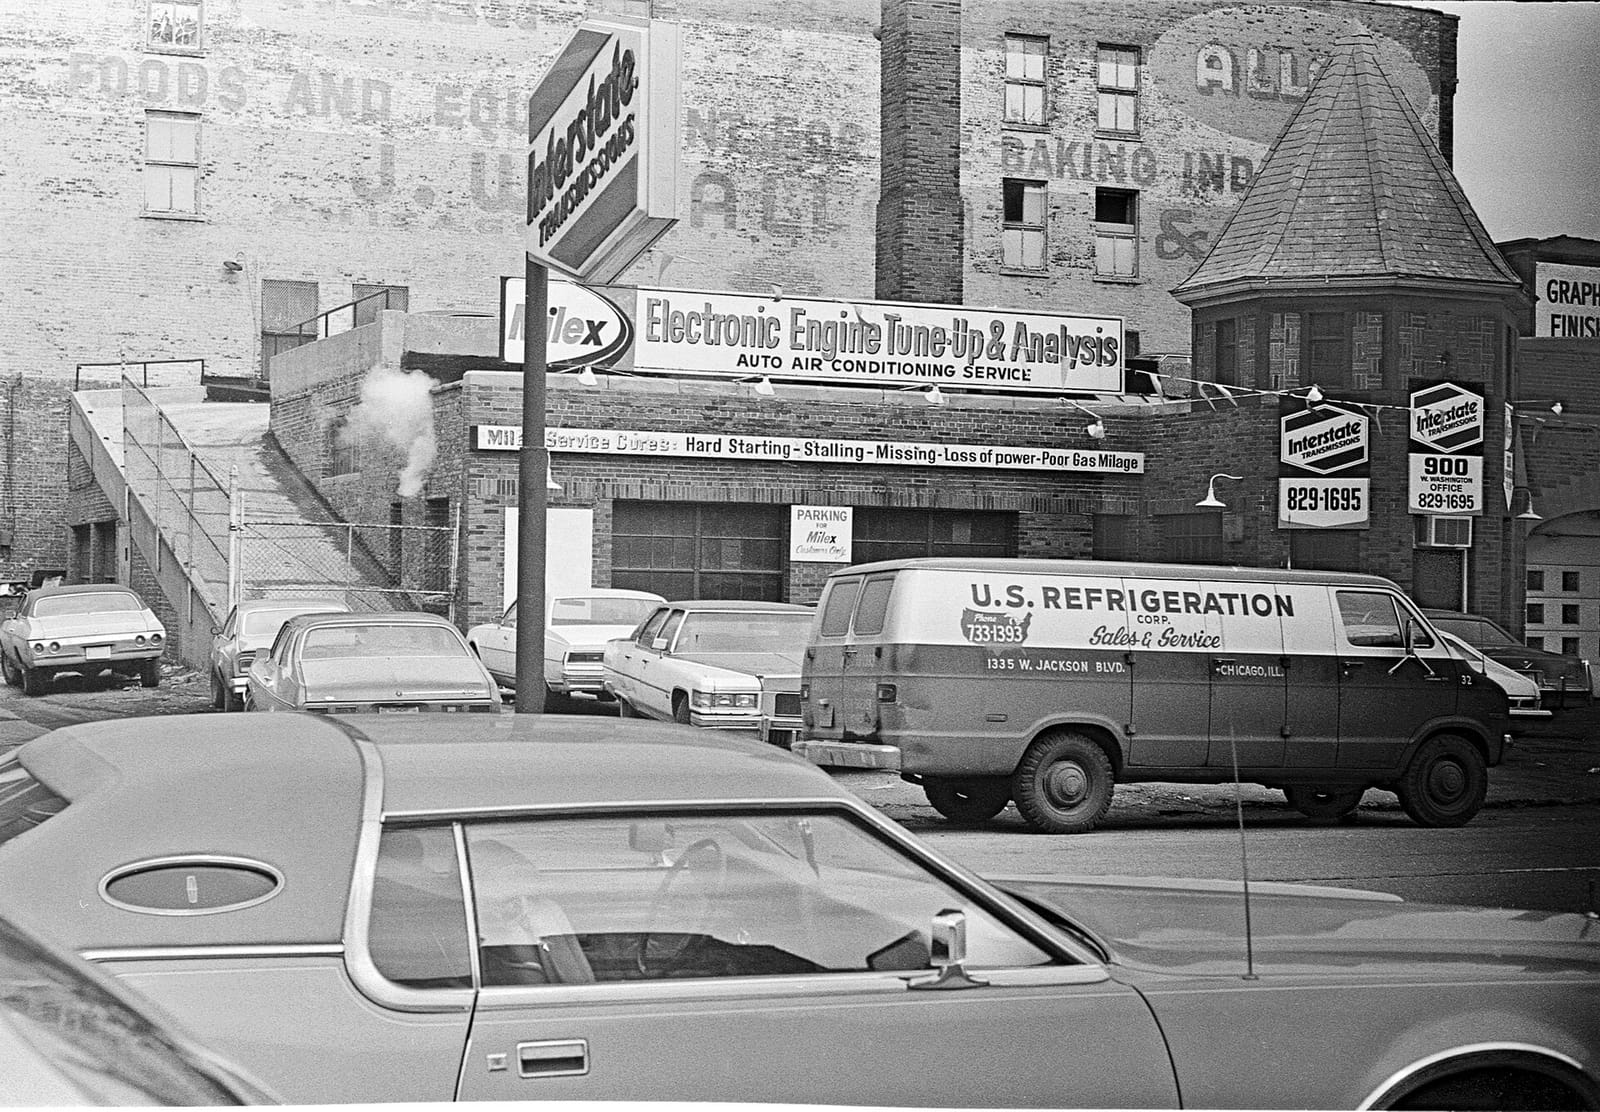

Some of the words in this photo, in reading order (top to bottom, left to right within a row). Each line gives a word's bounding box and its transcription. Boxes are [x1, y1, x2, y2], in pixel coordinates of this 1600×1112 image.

[1196, 44, 1325, 102] ALL
[69, 52, 248, 112] FOODS
[284, 68, 392, 125] AND
[1001, 135, 1156, 186] BAKING
[1182, 150, 1256, 194] IND
[527, 38, 635, 226] Interstate
[646, 297, 781, 349] Electronic
[790, 307, 882, 361] Engine
[884, 313, 984, 364] Tune-Up
[986, 319, 1006, 362] &
[1011, 321, 1119, 369] Analysis
[737, 353, 783, 368] AUTO
[792, 356, 823, 371] AIR
[831, 359, 956, 378] CONDITIONING
[963, 365, 1032, 381] SERVICE
[1416, 401, 1478, 433] Intestate
[1427, 414, 1478, 437] TRANSMISSIONS
[487, 429, 523, 447] Mil
[546, 431, 610, 449] Service
[616, 433, 678, 451] Cures:
[686, 436, 722, 453] Hard
[979, 449, 994, 463] of
[1073, 452, 1097, 468] Gas
[1098, 453, 1139, 472] Milage
[1288, 421, 1362, 456] Interstate
[1301, 435, 1361, 460] TRANSMISSIONS
[1424, 457, 1469, 476] 900
[1287, 487, 1362, 511] 829-1695
[1430, 484, 1463, 493] OFFICE
[1418, 493, 1475, 510] 829-1695
[797, 509, 848, 521] PARKING
[806, 531, 837, 544] Milex
[970, 583, 1035, 609] U.S.
[1042, 586, 1295, 617] REFRIGERATION
[1137, 615, 1171, 625] CORP.
[966, 624, 1023, 643] 733-1393
[1089, 625, 1140, 647] Sales
[1141, 632, 1152, 648] &
[1158, 627, 1221, 649] Service
[987, 658, 1015, 670] 1335
[1019, 659, 1034, 671] W.
[1036, 660, 1089, 673] JACKSON
[1096, 662, 1126, 673] BLVD.
[1461, 675, 1473, 685] 32
